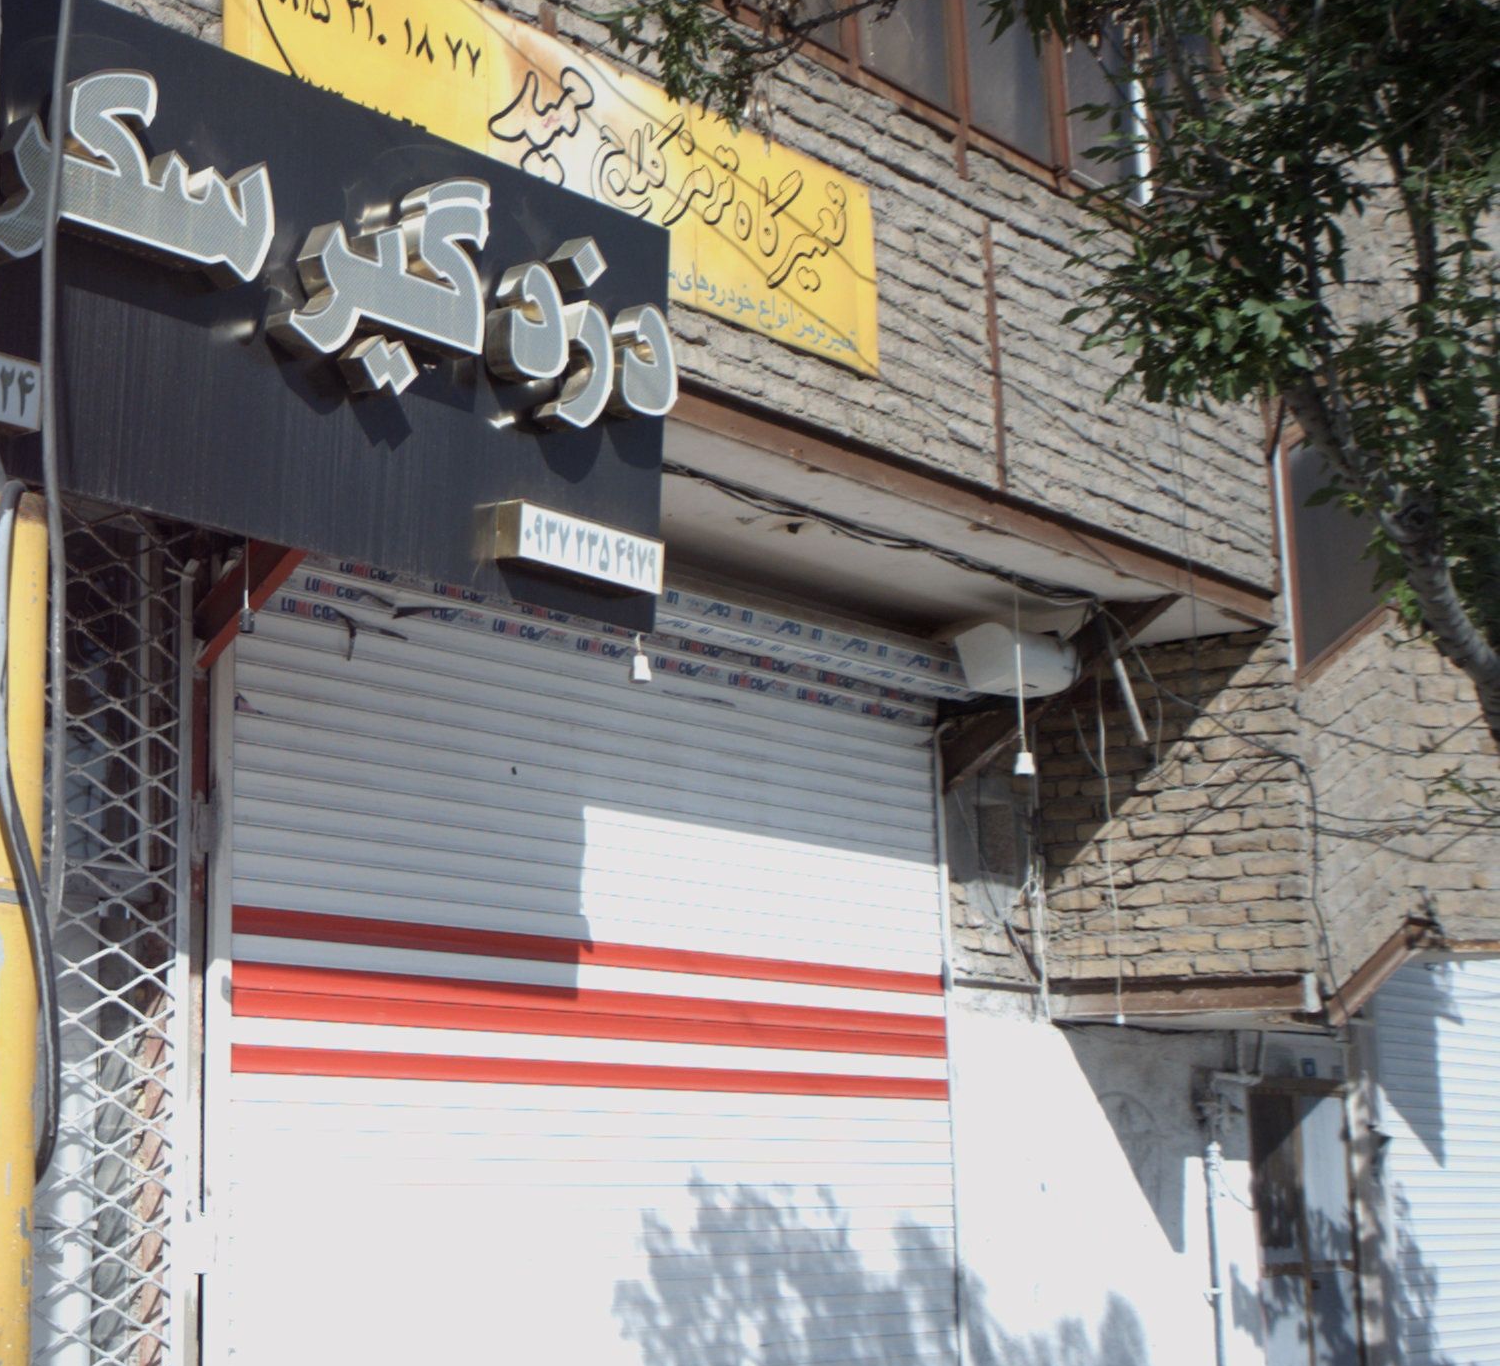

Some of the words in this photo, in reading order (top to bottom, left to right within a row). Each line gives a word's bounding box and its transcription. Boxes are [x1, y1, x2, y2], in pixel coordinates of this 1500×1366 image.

[403, 17, 435, 65] ۱۸
[444, 31, 482, 78] ۷۷
[525, 513, 570, 559] ۰۹۳۷
